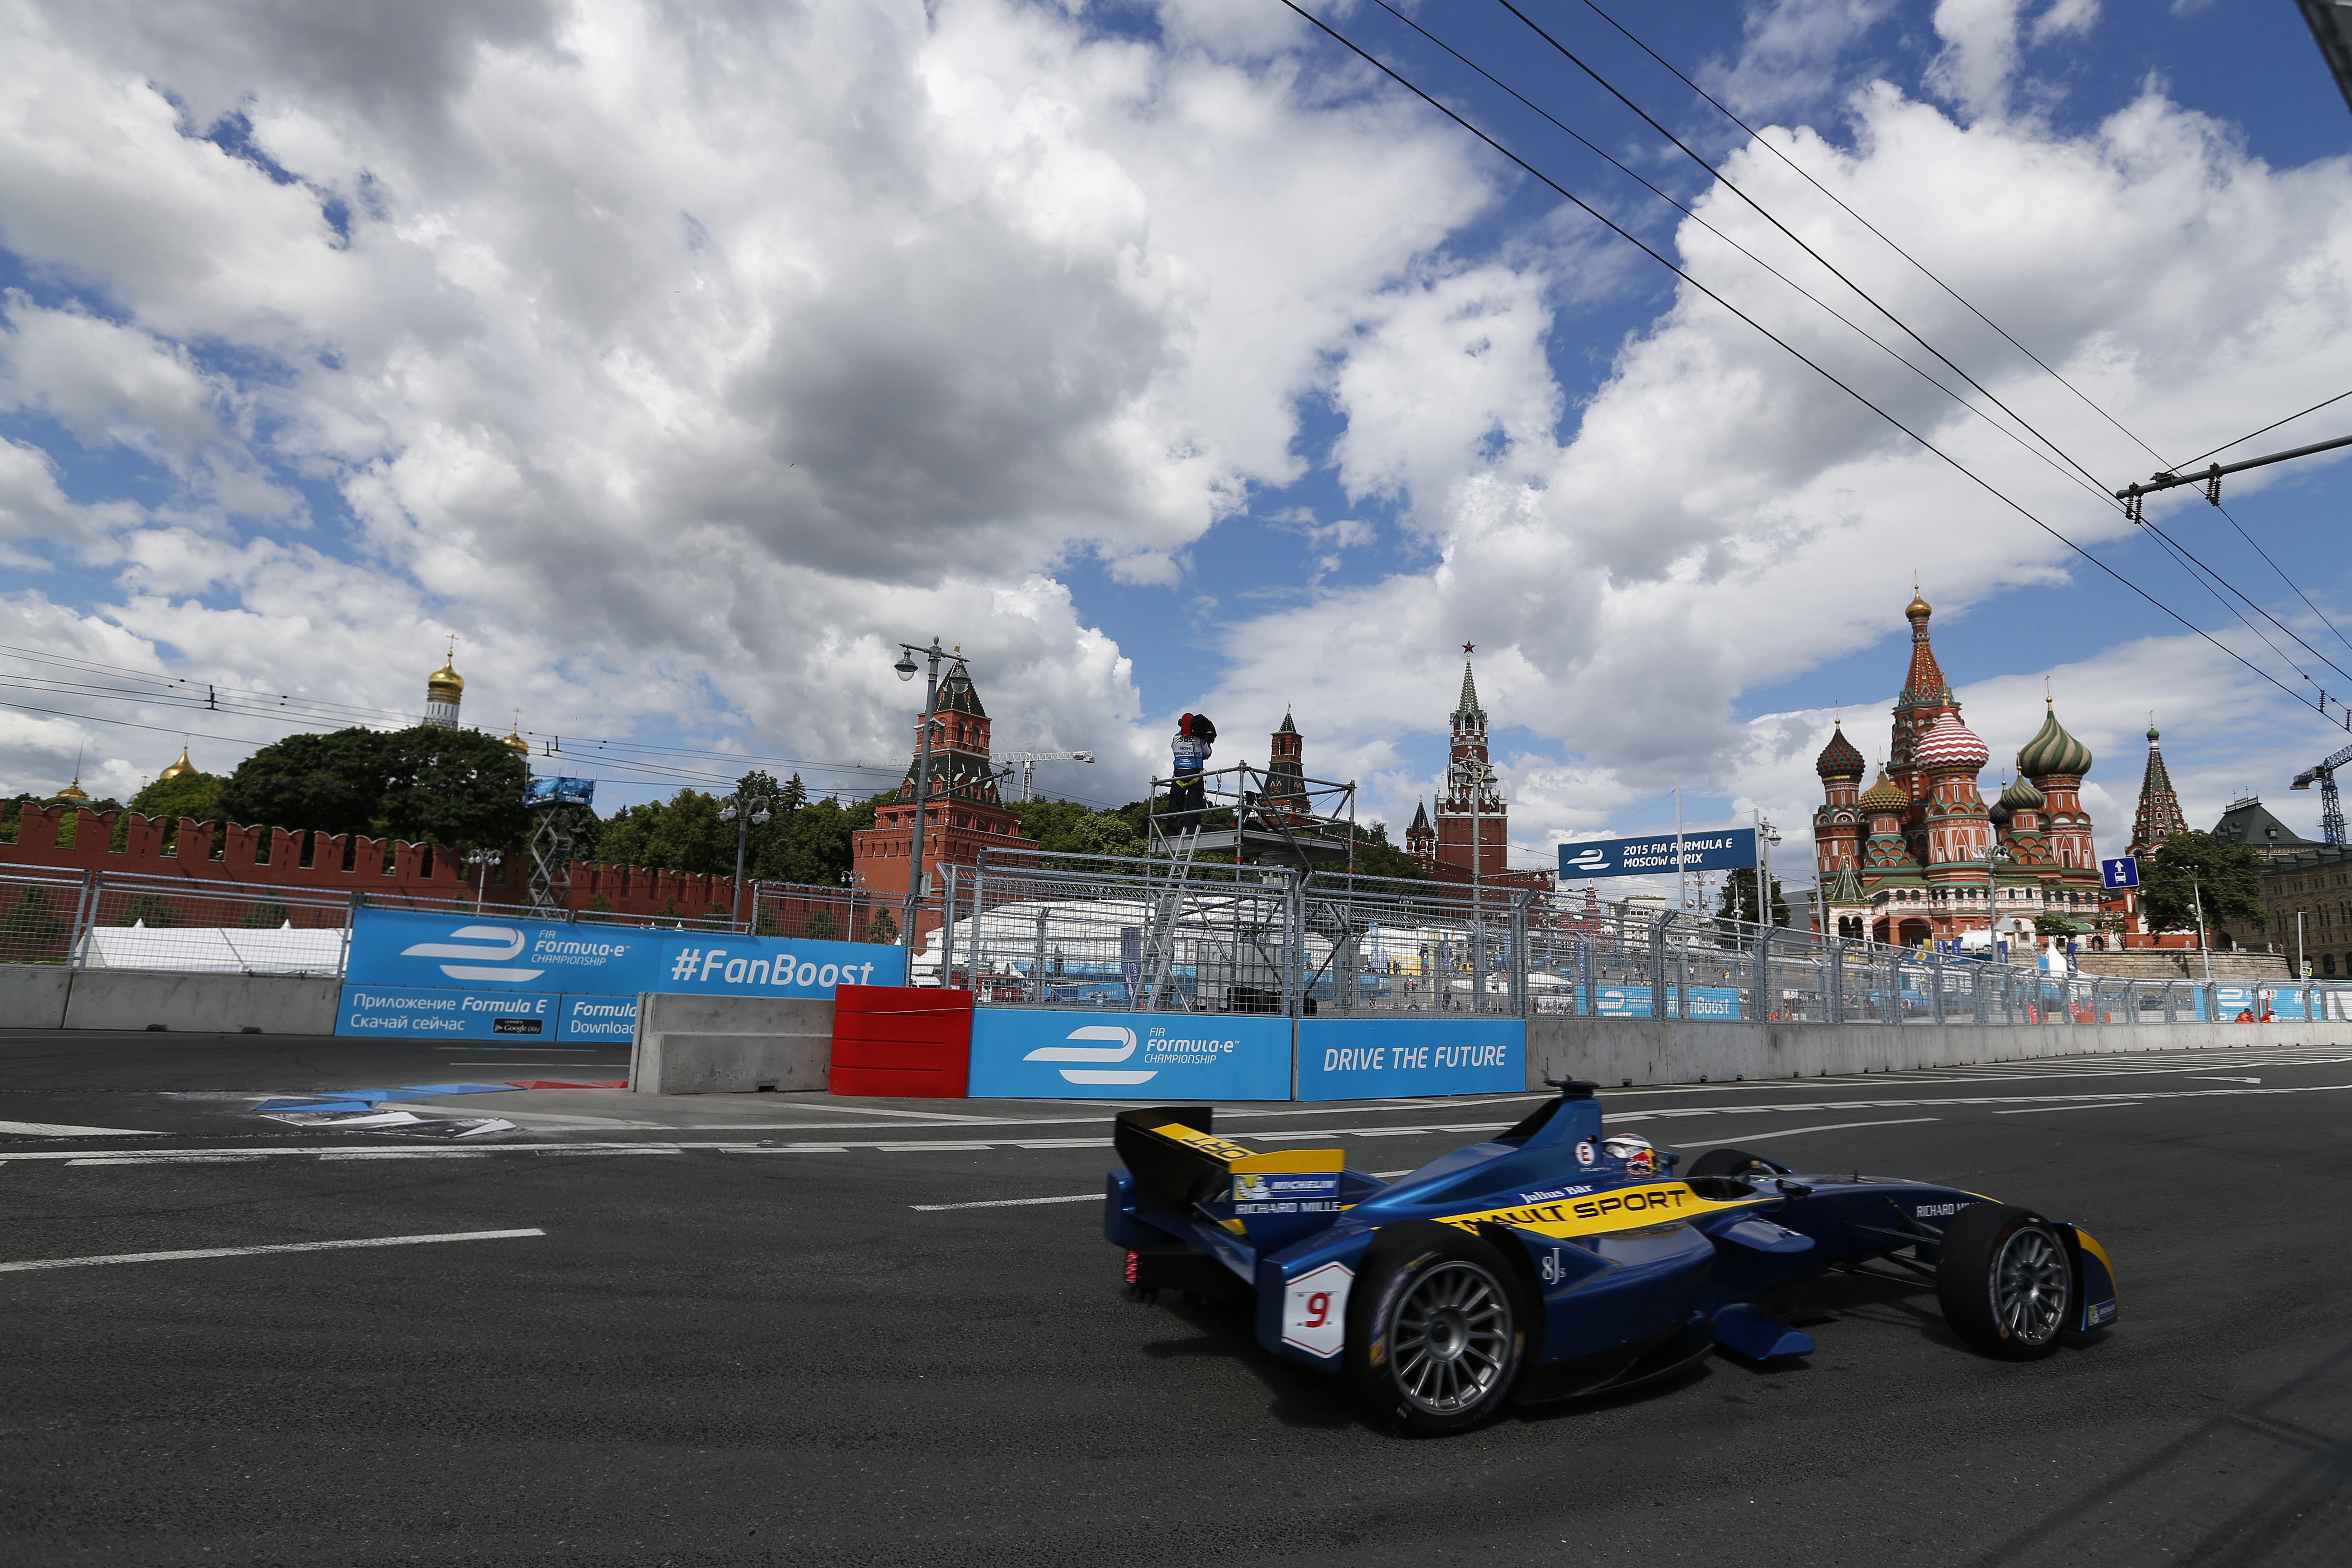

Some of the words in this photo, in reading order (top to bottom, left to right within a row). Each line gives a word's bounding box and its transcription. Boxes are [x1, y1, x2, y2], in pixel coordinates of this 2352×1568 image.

[1623, 844, 1649, 856] 2015
[1651, 843, 1667, 854] FIA
[1725, 838, 1733, 848] E
[1623, 855, 1668, 868] MOSCOW
[538, 929, 556, 939] FIA
[531, 954, 607, 966] CHAMPIONSHIP
[671, 948, 874, 987] #FanBoost
[353, 993, 456, 1011] Приложение
[461, 996, 531, 1013] Formula
[535, 999, 548, 1014] E
[351, 1014, 408, 1029] Скачай
[412, 1016, 465, 1031] сейчас
[504, 1024, 527, 1033] Google
[1149, 1027, 1166, 1037] FIA
[1144, 1054, 1217, 1064] CHAMPIONSHIP
[1323, 1048, 1385, 1071] DRIVE
[1392, 1046, 1429, 1069] THE
[1434, 1045, 1507, 1068] FUTURE
[1271, 1180, 1336, 1190] MICHELIN
[1519, 1187, 1565, 1204] Julius
[1568, 1183, 1593, 1196] Bär
[1235, 1202, 1298, 1214] RICHARD
[1299, 1201, 1342, 1212] MILLE
[1574, 1190, 1687, 1219] SPORT
[1916, 1203, 1955, 1217] RICHARD
[1306, 1292, 1329, 1328] 9
